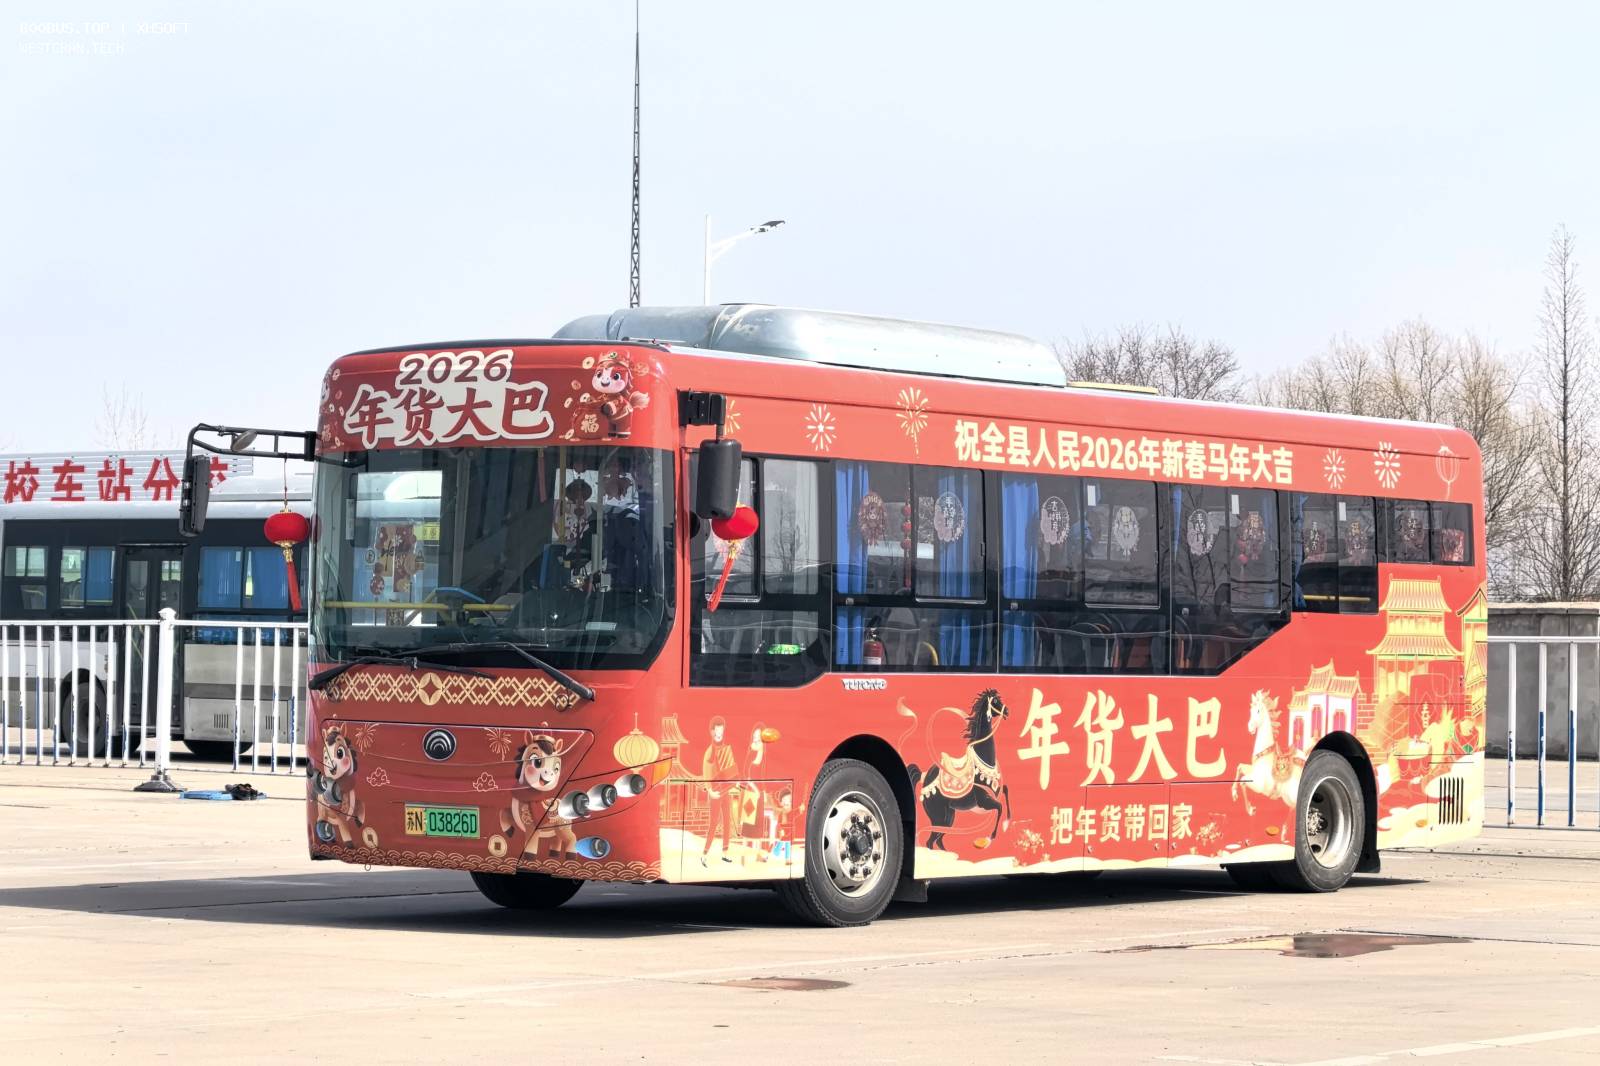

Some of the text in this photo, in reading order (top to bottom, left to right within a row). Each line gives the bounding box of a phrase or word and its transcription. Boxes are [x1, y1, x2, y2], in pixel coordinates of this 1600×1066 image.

[400, 353, 508, 385] 2026
[348, 386, 550, 445] 年货大巴
[954, 419, 1294, 484] 祝全县人民2026年新春马年大吉
[1017, 687, 1228, 791] 年货大巴
[1050, 802, 1194, 845] 把年货带回家
